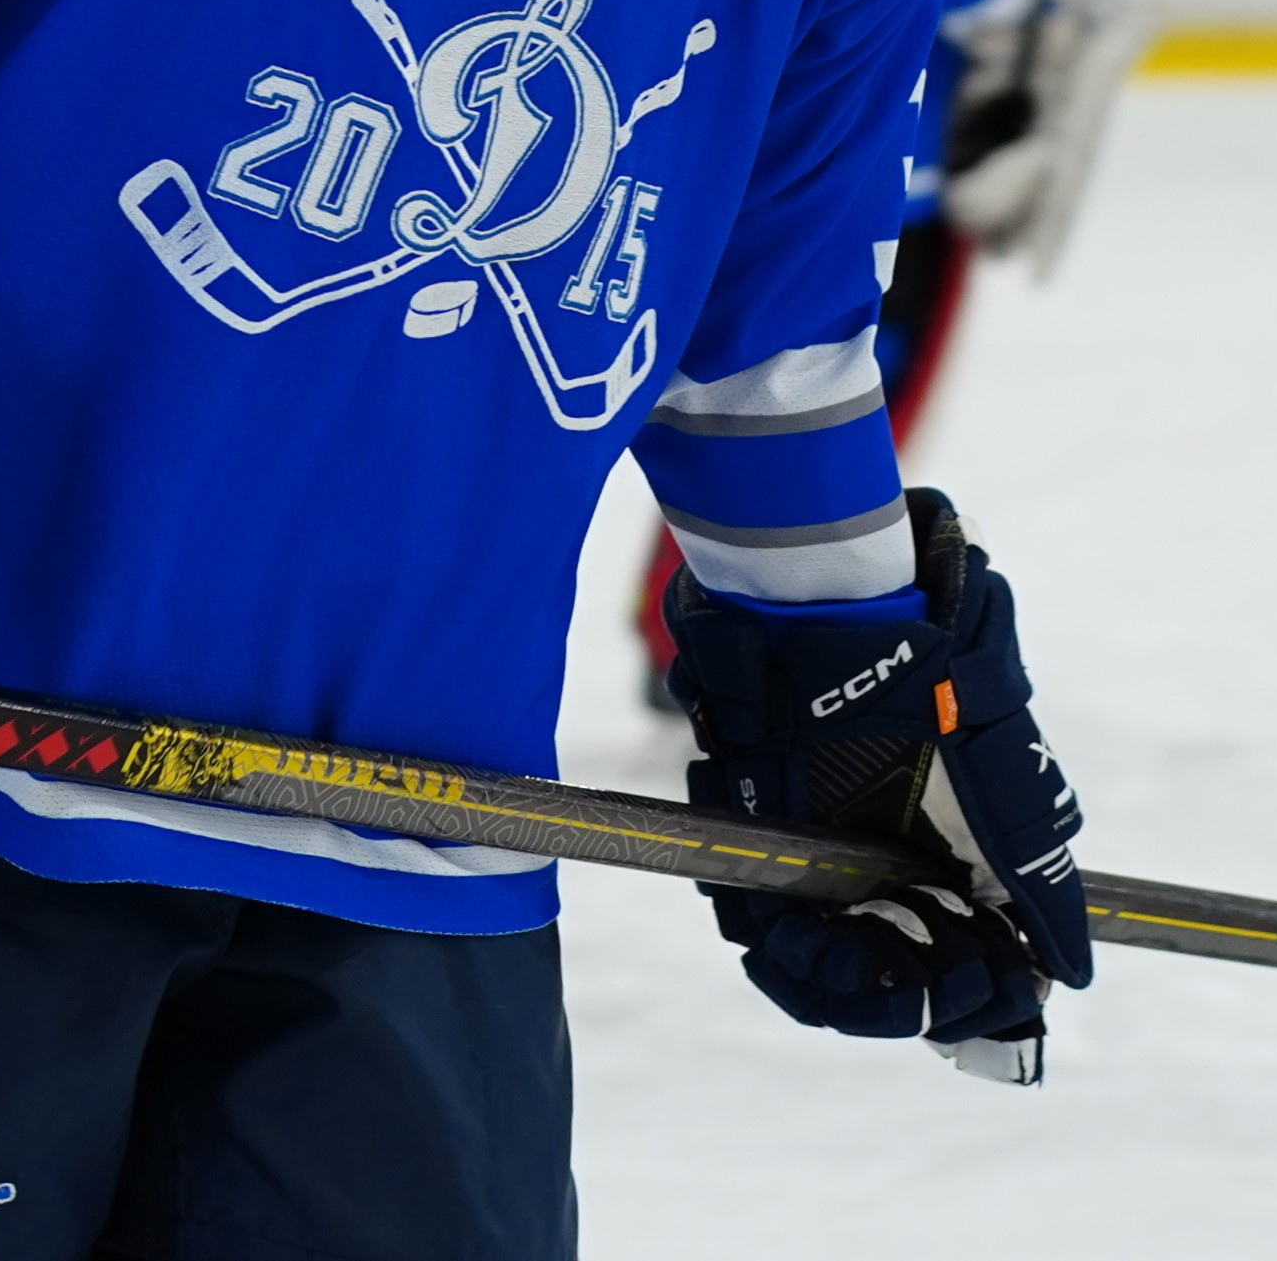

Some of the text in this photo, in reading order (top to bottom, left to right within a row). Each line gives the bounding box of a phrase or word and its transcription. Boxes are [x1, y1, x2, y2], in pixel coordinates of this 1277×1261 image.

[206, 65, 403, 243] 20
[558, 175, 663, 323] 15
[810, 639, 914, 718] CCM
